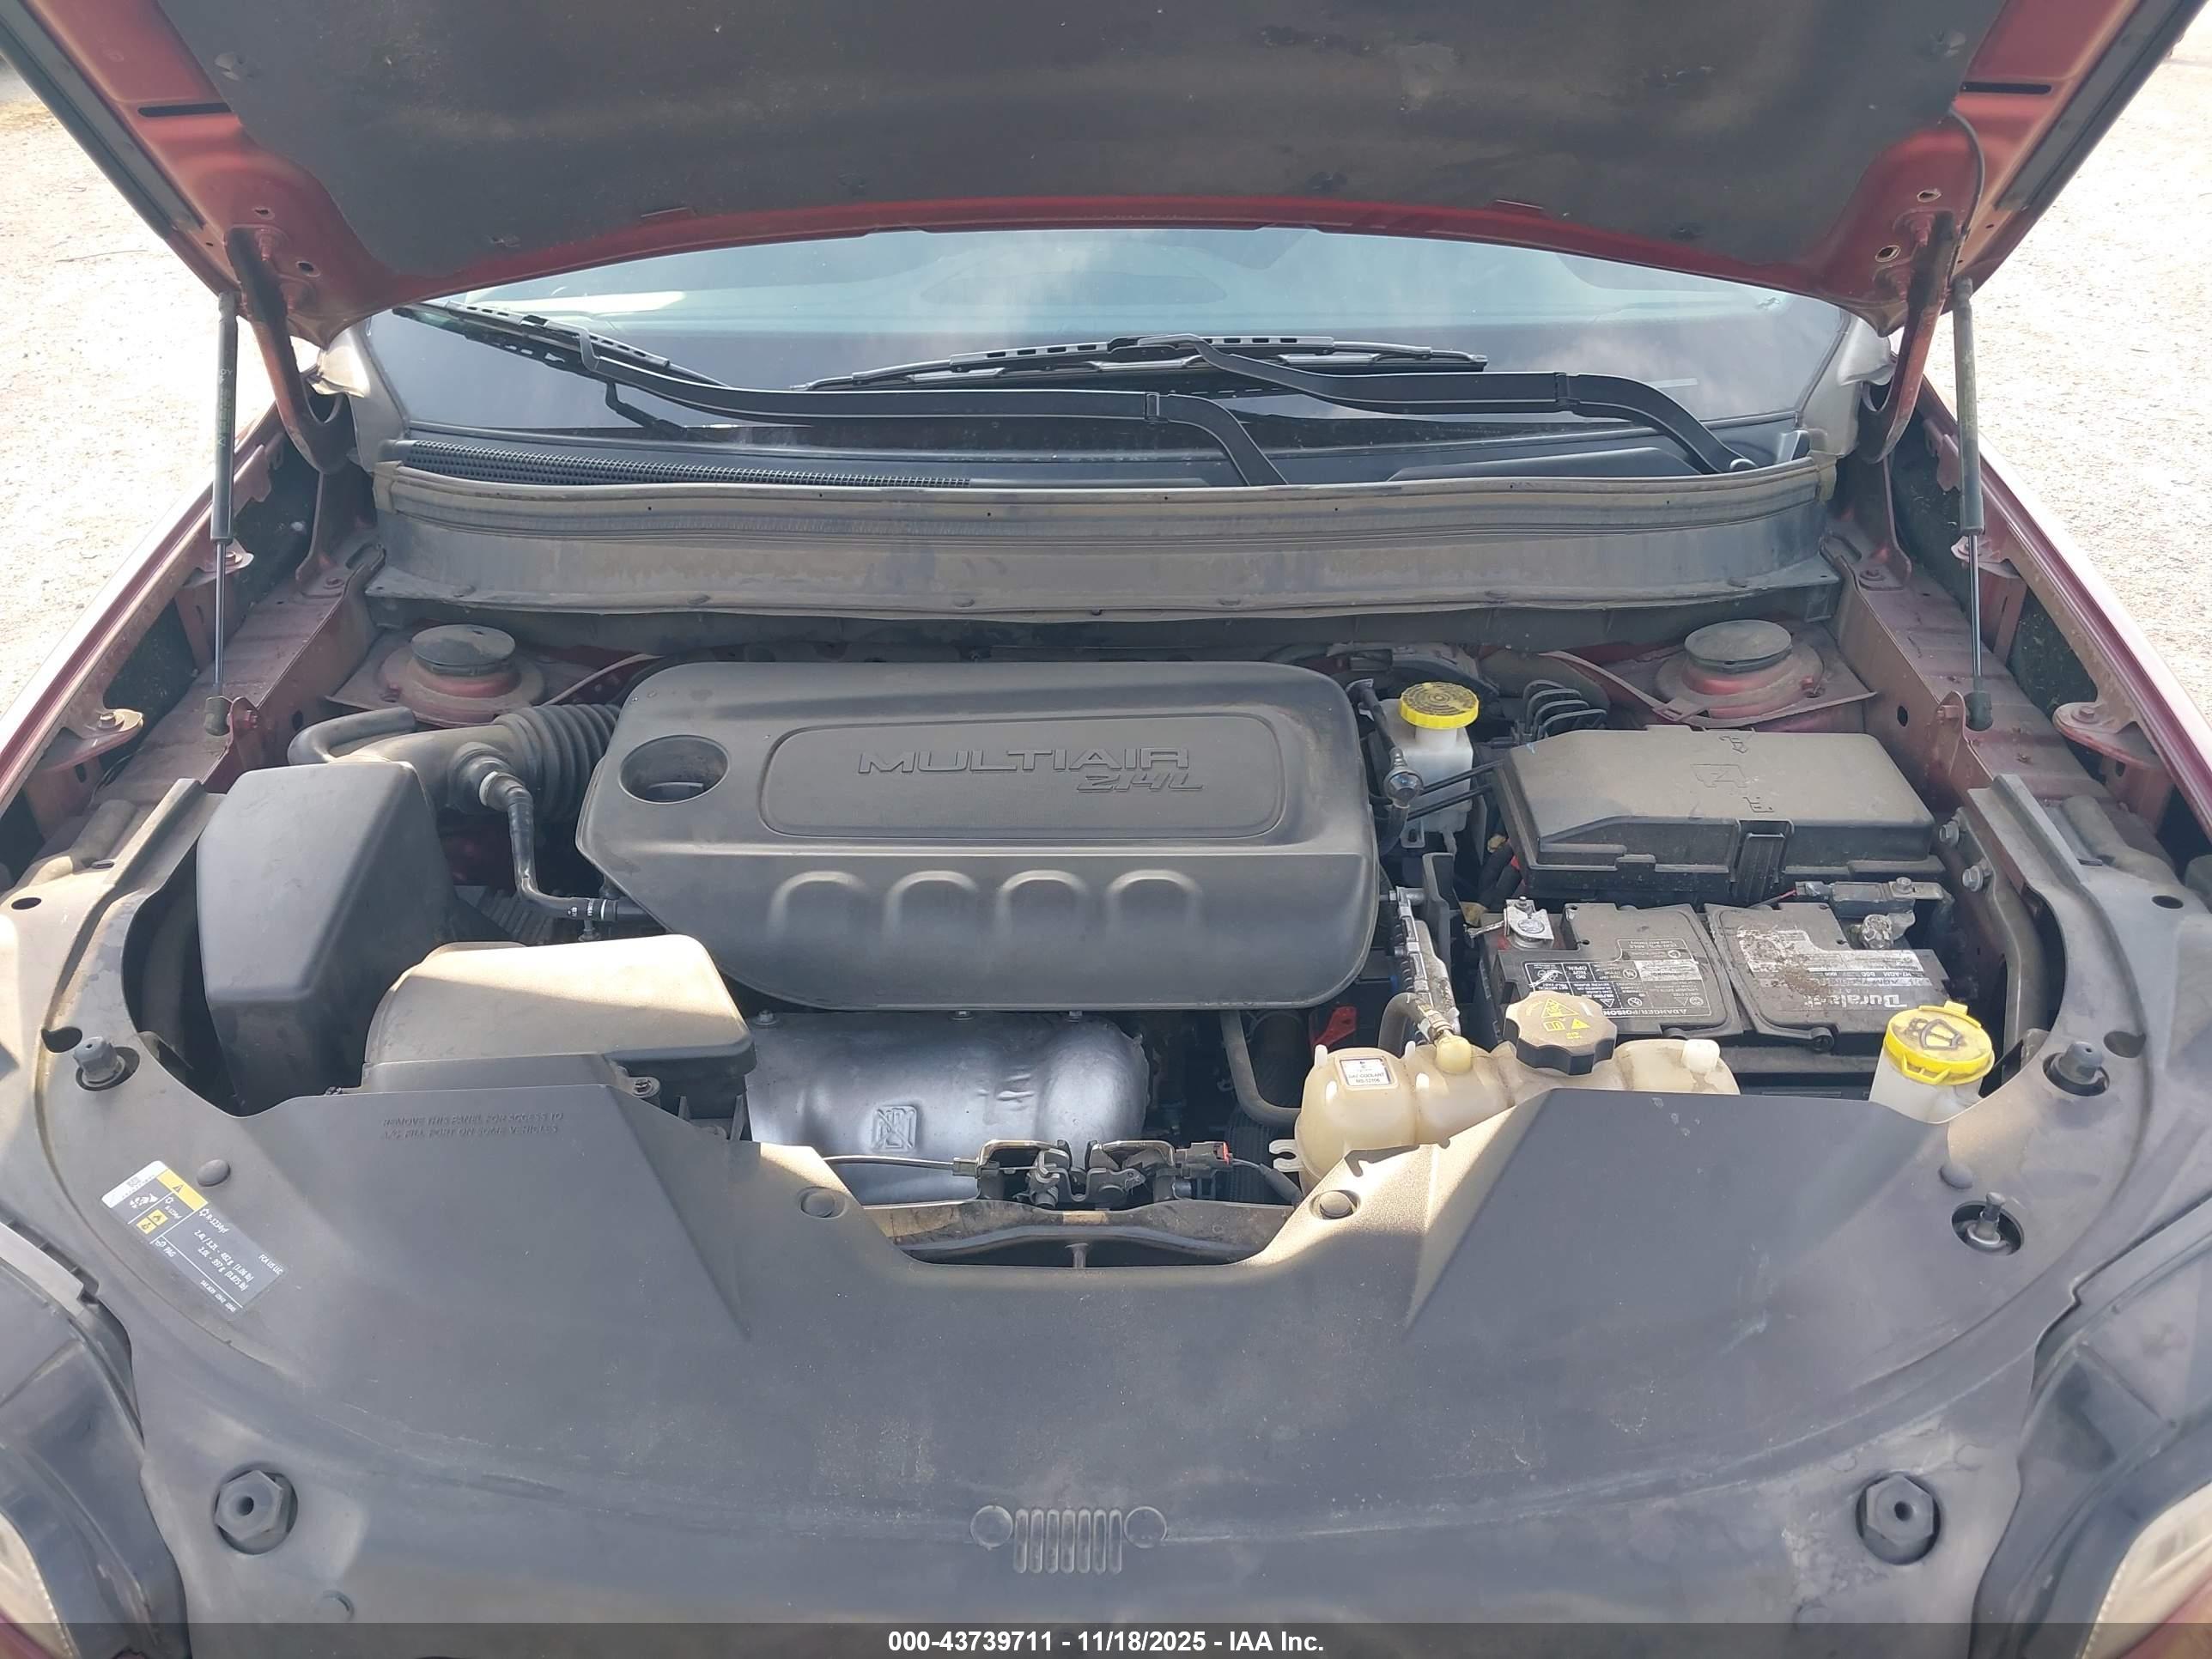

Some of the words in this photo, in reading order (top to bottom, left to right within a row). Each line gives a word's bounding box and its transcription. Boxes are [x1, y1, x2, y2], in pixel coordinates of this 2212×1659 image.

[859, 748, 1189, 774] MULTIAIR
[204, 1215, 230, 1235] R-1234yf
[162, 1247, 176, 1257] PAG
